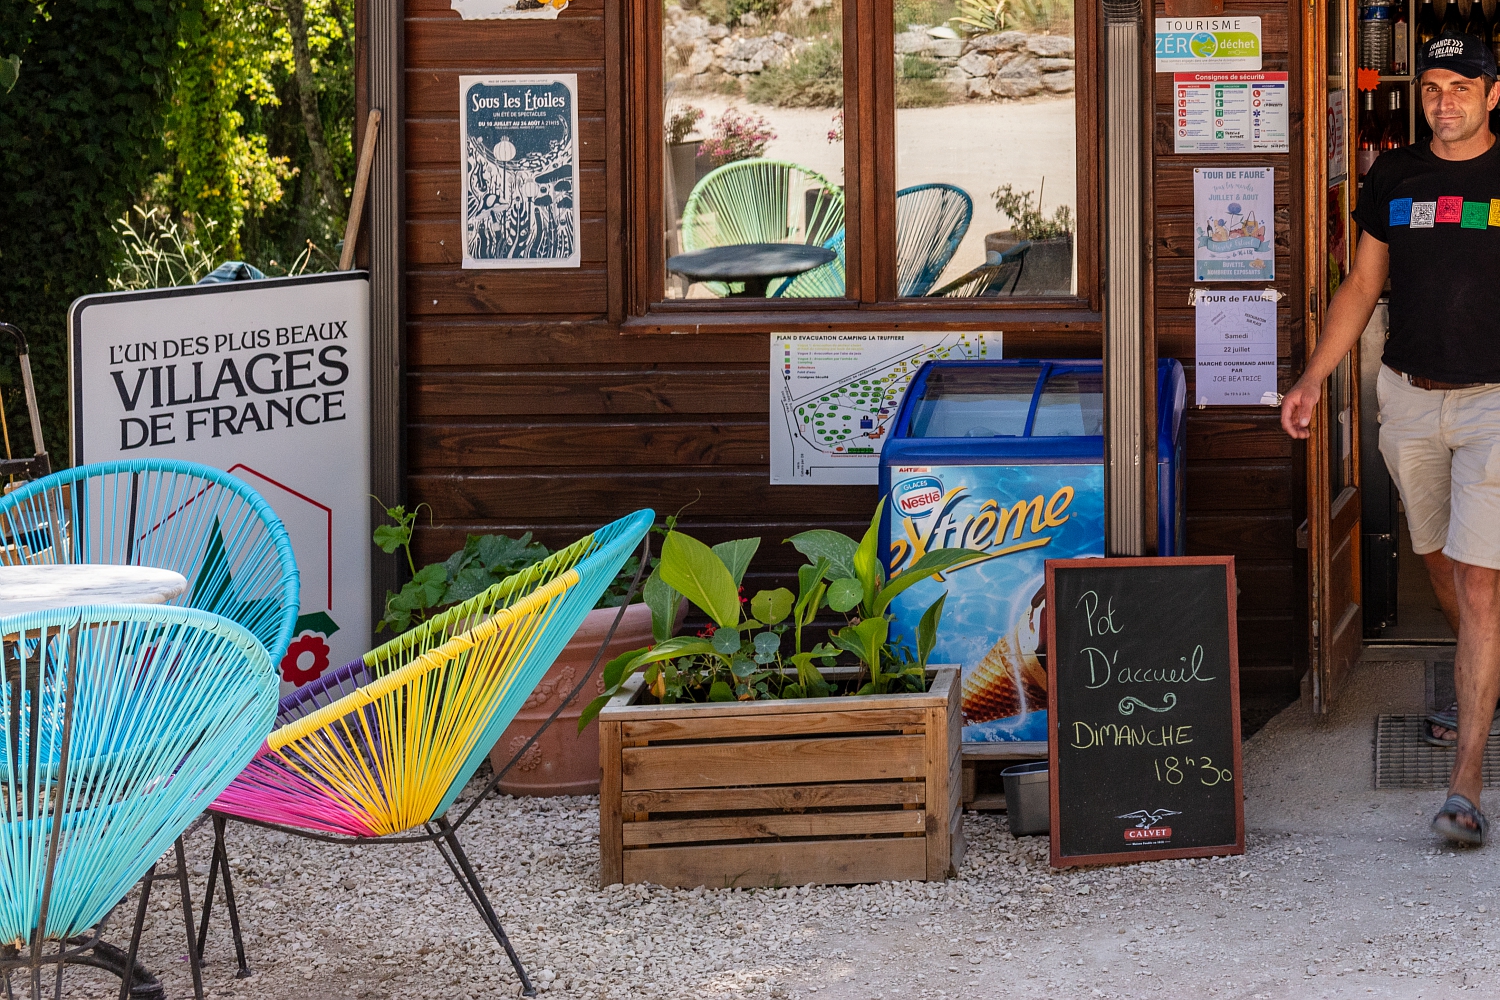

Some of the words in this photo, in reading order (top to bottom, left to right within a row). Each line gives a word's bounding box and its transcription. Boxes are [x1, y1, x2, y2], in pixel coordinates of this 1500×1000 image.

[1166, 20, 1242, 31] TOURISME
[1220, 38, 1255, 49] déchet
[472, 93, 500, 112] Sous
[503, 92, 521, 109] les
[524, 89, 566, 111] Étoiles
[1202, 171, 1224, 180] TOUR
[1226, 171, 1236, 179] DE
[1238, 170, 1265, 178] FAURE
[163, 336, 210, 359] DES
[215, 329, 270, 353] PLUS
[276, 320, 348, 346] BEAUX
[110, 345, 350, 412] VILLAGES
[120, 412, 176, 450] DE
[186, 390, 346, 442] FRANCE
[904, 480, 928, 490] GLACES
[901, 490, 940, 510] Nestlé
[1076, 590, 1124, 637] Pot
[1080, 644, 1216, 689] D'accueil
[1129, 829, 1166, 838] CALVET
